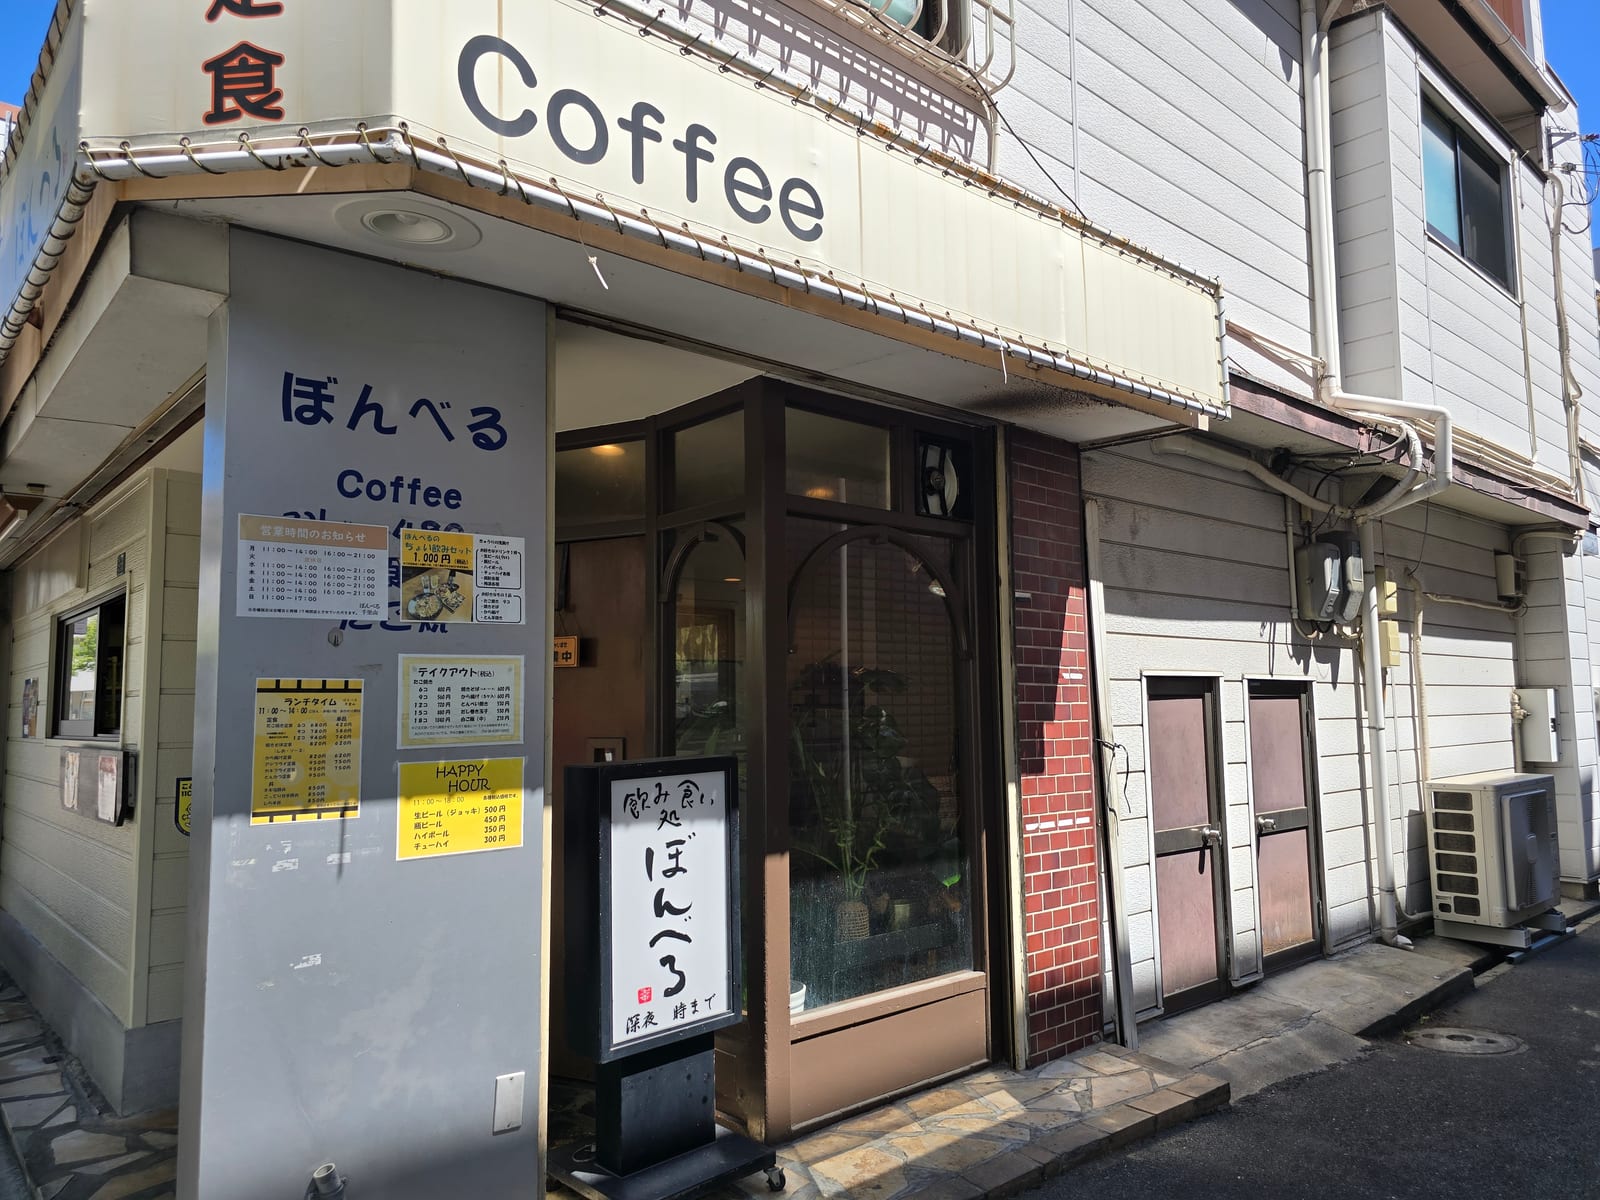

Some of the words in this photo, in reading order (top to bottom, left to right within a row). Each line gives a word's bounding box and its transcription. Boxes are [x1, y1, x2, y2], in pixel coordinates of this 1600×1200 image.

[202, 0, 286, 125] 食
[457, 34, 824, 242] Coffee
[282, 371, 508, 451] ぼんべる
[337, 469, 463, 510] Coffee
[260, 525, 367, 543] 営業時間のお知らせ
[284, 697, 337, 706] ランチタイム
[436, 764, 485, 779] HAPPY
[448, 778, 491, 793] HOUR
[414, 830, 450, 840] ハイボール
[414, 840, 450, 851] チューハイ
[626, 1011, 658, 1034] 深夜
[673, 993, 716, 1020] 時まで
